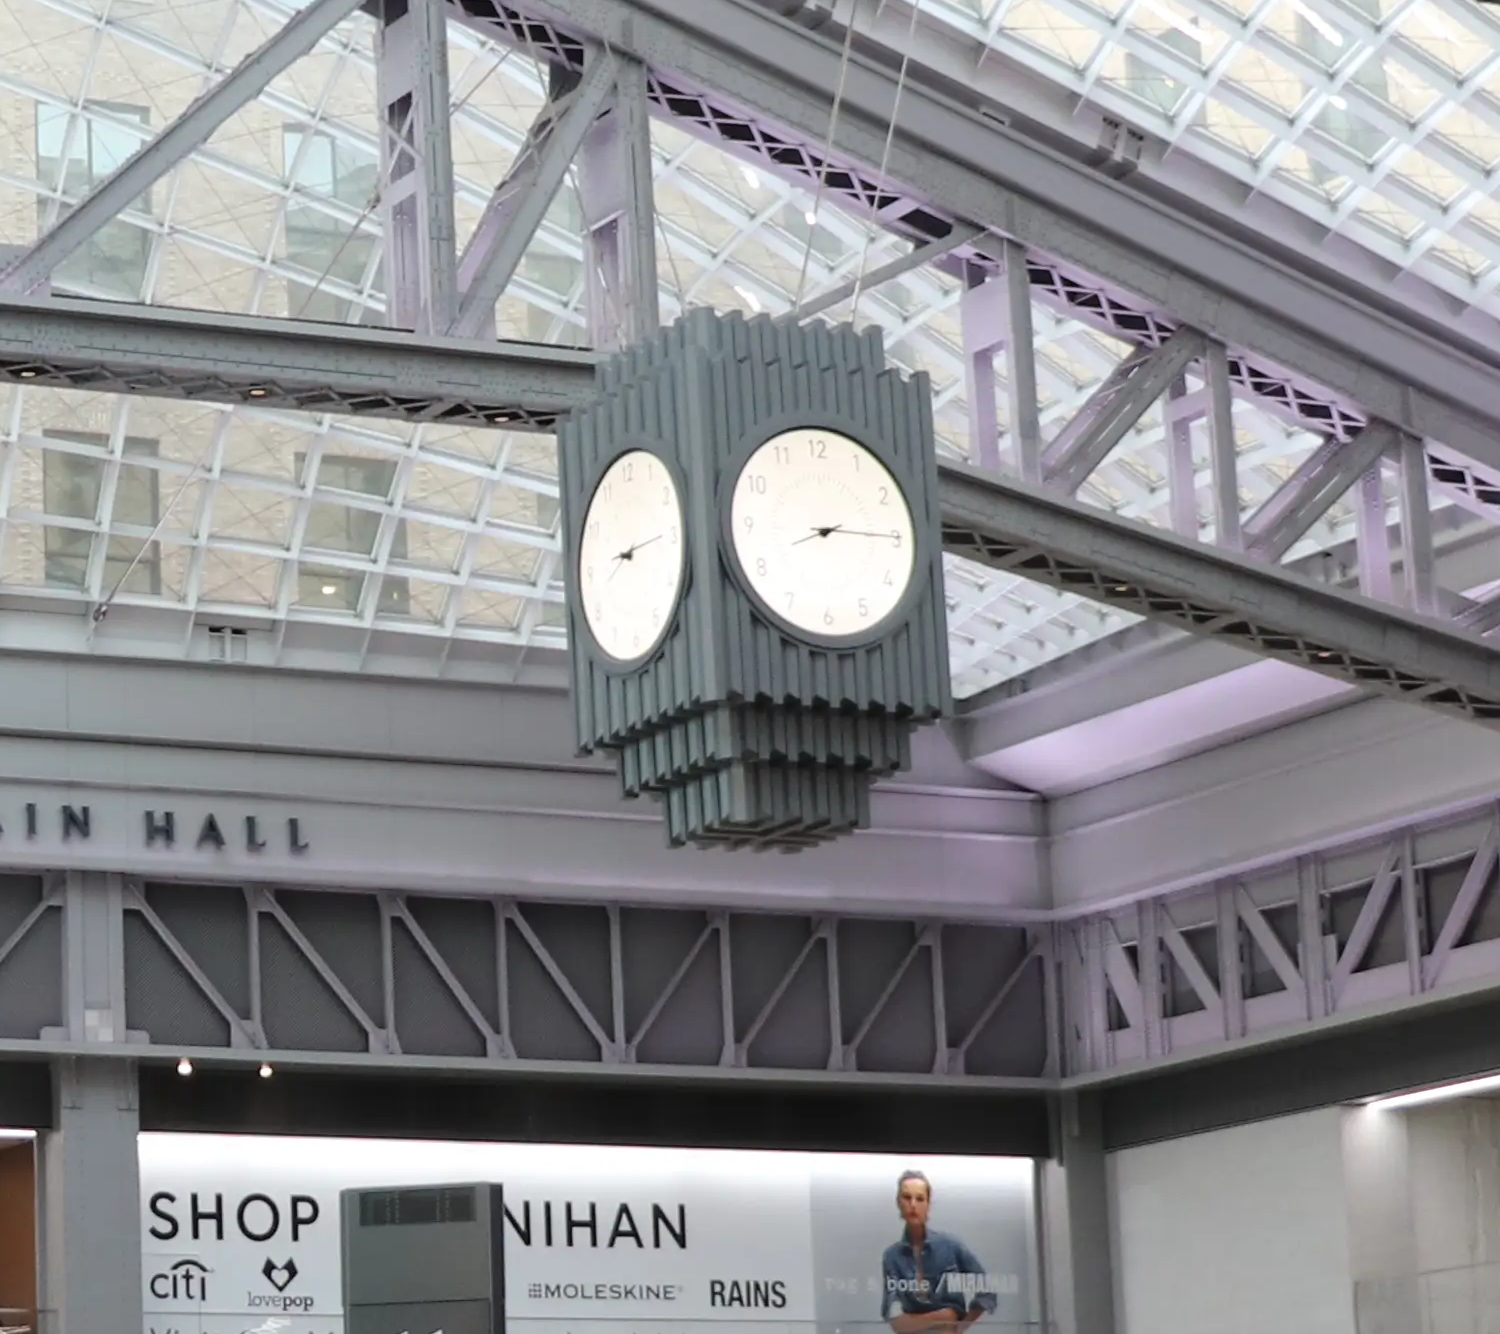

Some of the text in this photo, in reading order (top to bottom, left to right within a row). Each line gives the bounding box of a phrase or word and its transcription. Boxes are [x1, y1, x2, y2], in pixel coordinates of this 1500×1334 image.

[774, 446, 790, 465] 11
[808, 440, 828, 459] 12
[622, 462, 634, 482] 12
[853, 454, 860, 472] 1
[748, 475, 767, 495] 10
[878, 486, 889, 505] 2
[744, 516, 754, 535] 9
[890, 530, 901, 548] 3
[756, 557, 767, 577] 8
[882, 569, 893, 587] 4
[784, 592, 795, 610] 7
[858, 598, 868, 617] 5
[823, 607, 834, 626] 6
[143, 809, 312, 854] HALL
[148, 1191, 688, 1249] SHOP NIHAN
[150, 1259, 207, 1301] citi
[886, 1275, 931, 1292] bone
[544, 1283, 676, 1300] MOLESKINE
[709, 1279, 787, 1308] RAINS
[247, 1292, 314, 1311] lovepop
